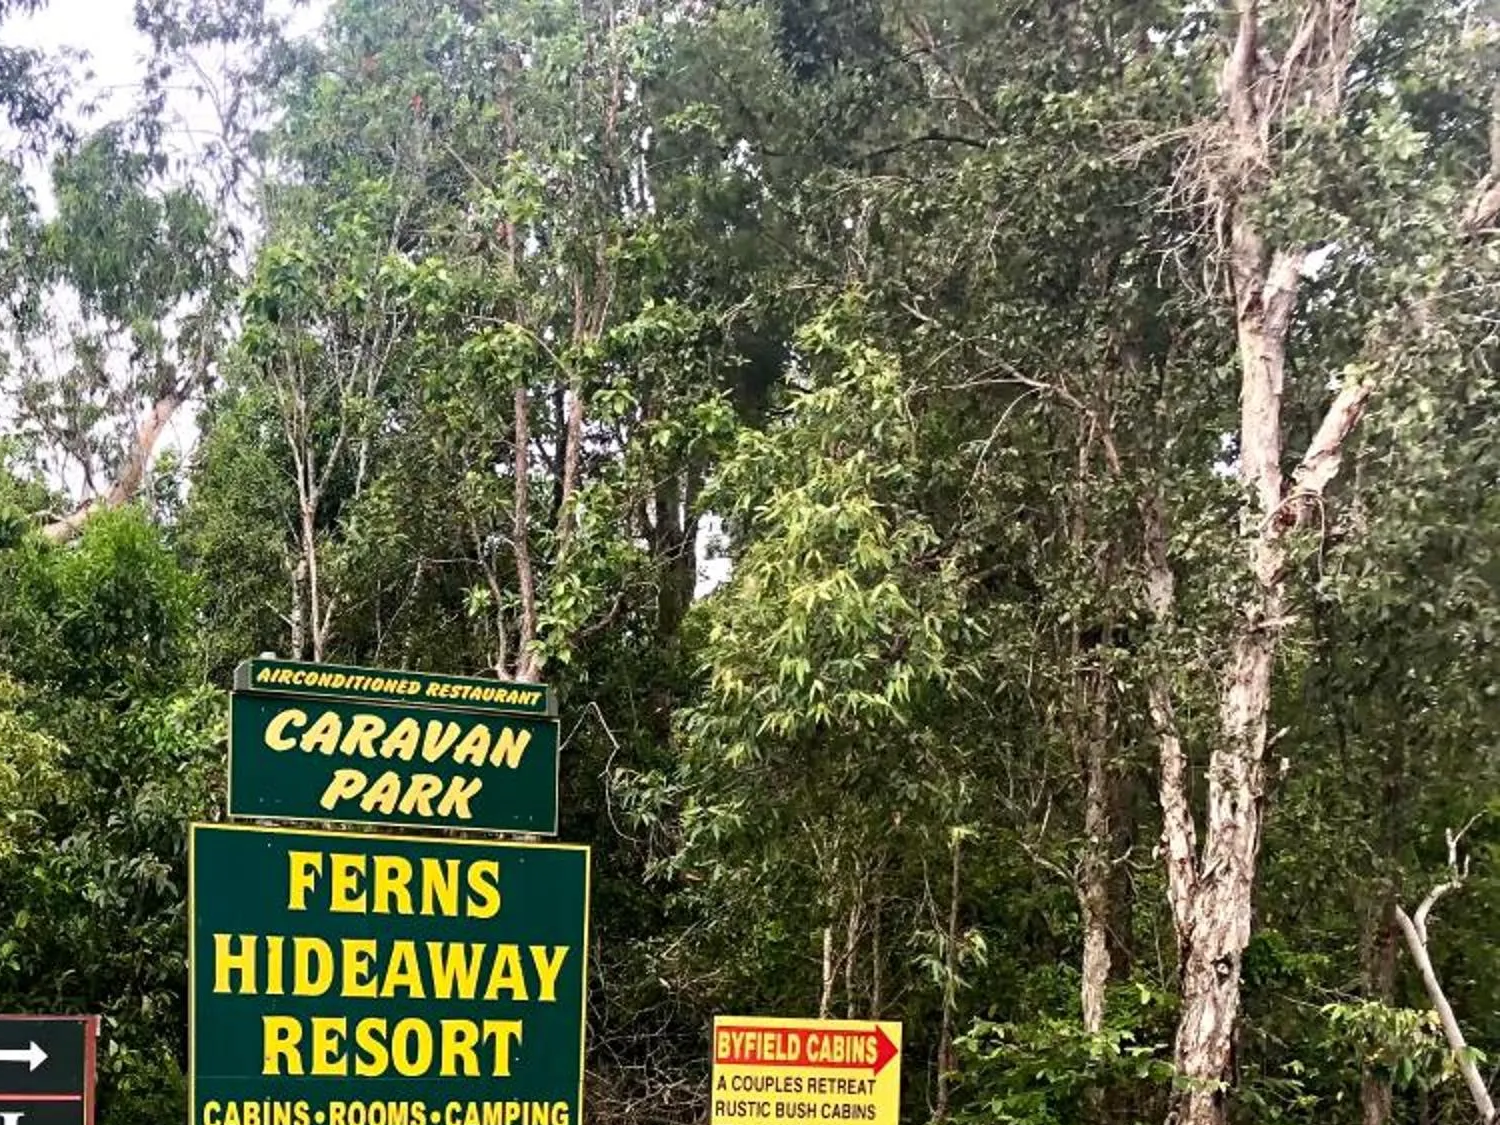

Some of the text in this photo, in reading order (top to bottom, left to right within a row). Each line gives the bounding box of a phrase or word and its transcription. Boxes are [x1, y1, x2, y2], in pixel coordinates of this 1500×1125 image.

[256, 667, 543, 706] AIRCONDITIONED RESTAURANT
[264, 708, 532, 769] CARAVAN
[319, 768, 483, 819] PARK
[287, 850, 501, 919] FERNS
[212, 933, 570, 1001] HIDEAWAY
[261, 1015, 523, 1077] RESORT
[717, 1031, 878, 1064] BYFIELD CABINS
[716, 1075, 876, 1095] A COUPLES RETREAT
[716, 1101, 876, 1120] RUSTIC BUSH CABINS
